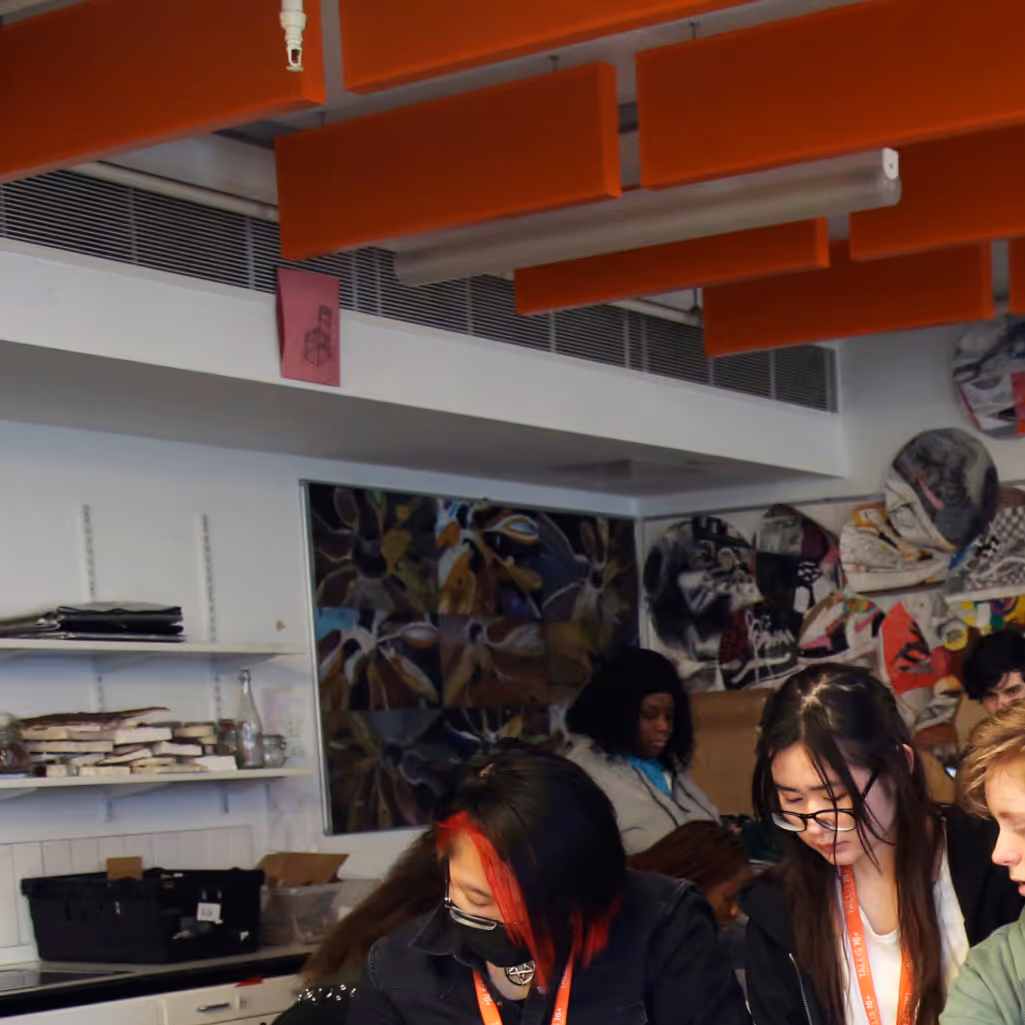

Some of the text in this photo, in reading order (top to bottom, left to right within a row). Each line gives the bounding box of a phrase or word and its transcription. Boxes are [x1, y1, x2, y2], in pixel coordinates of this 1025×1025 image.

[851, 932, 864, 979] TALLIS 16+
[865, 995, 874, 1010] 16+
[553, 1007, 562, 1022] 16+
